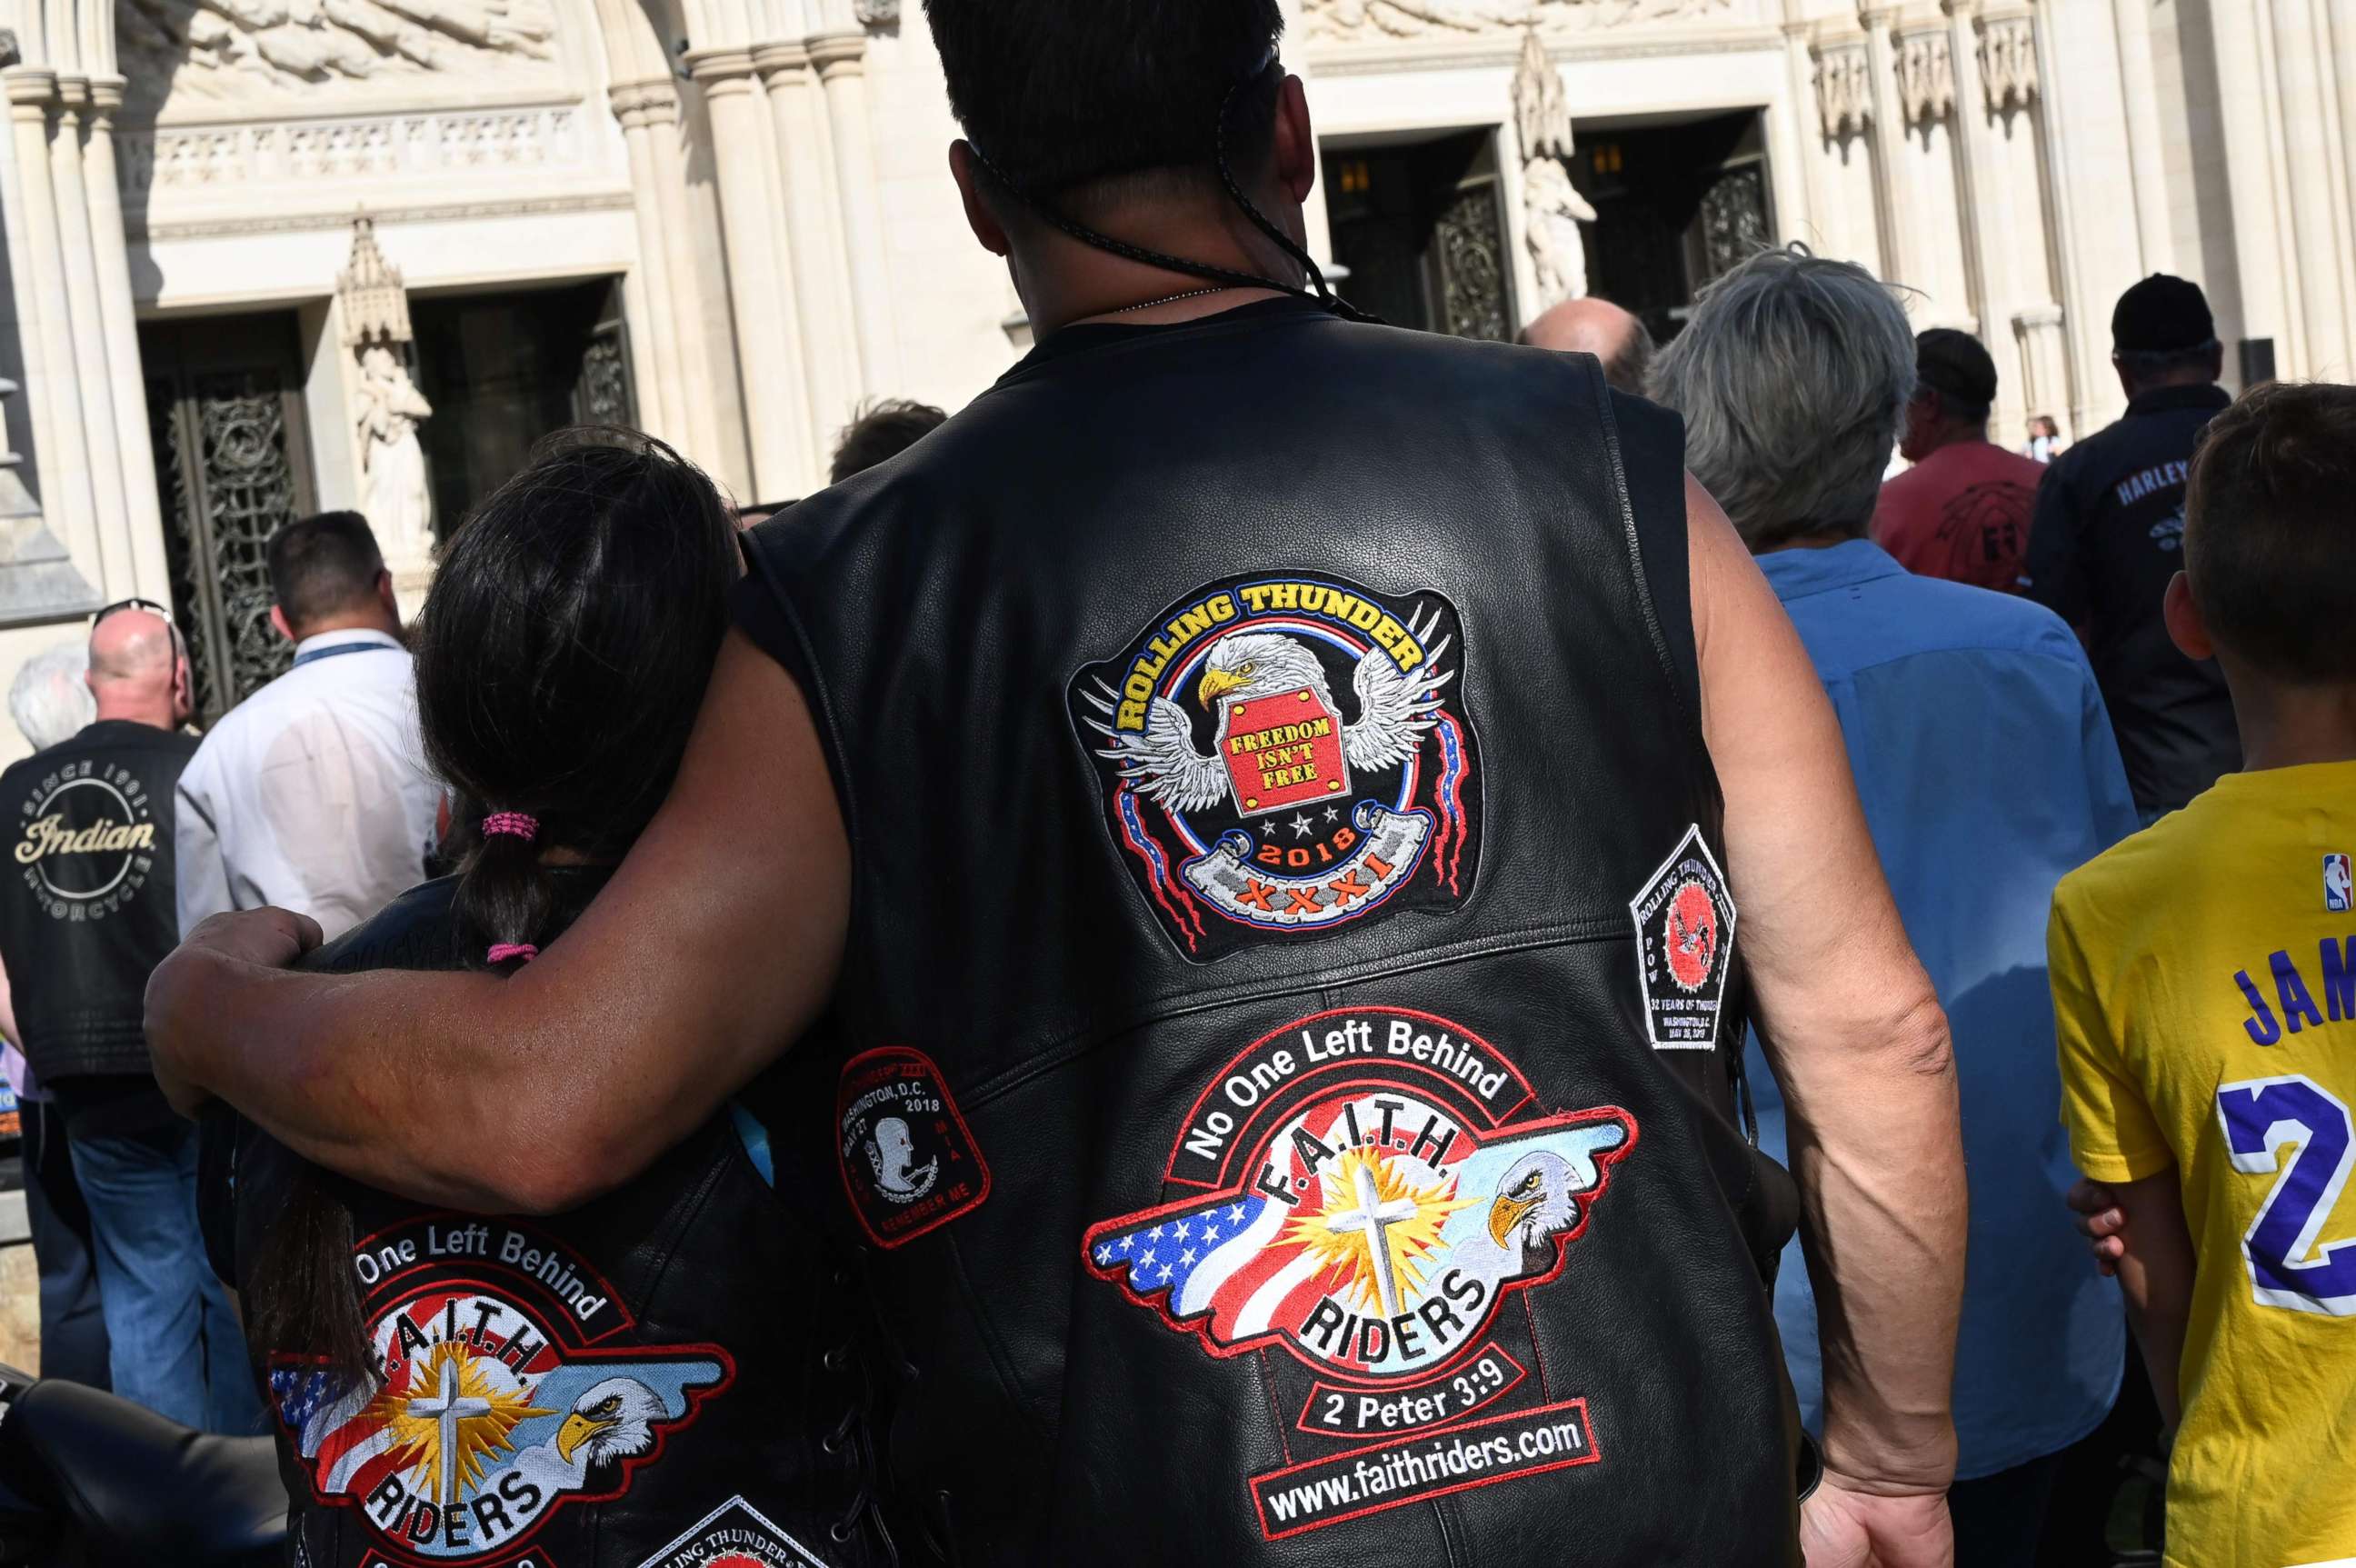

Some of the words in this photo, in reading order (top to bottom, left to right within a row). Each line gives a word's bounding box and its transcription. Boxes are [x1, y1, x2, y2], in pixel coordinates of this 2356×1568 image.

[2117, 460, 2188, 506] HARLEY
[1117, 594, 1234, 731] ROLLING
[1241, 584, 1422, 673] THUNDER
[1229, 717, 1331, 756] FREEDOM
[1263, 762, 1318, 790] FREE
[15, 813, 155, 864] Indian
[1257, 826, 1355, 867] 2018
[1237, 856, 1393, 914] XXXI
[1639, 872, 1678, 926] ROLLING
[1678, 858, 1717, 894] THUNDER
[1651, 998, 1660, 1011] 32
[1661, 999, 1684, 1011] YEARS
[1686, 999, 1695, 1011] OF
[855, 1118, 868, 1135] 27
[905, 1098, 940, 1113] 2018
[900, 1081, 925, 1098] D.C.
[1184, 1110, 1233, 1162] No
[1225, 1046, 1296, 1106] One
[1302, 1019, 1374, 1064] Left
[1387, 1019, 1507, 1101] Behind
[355, 1238, 417, 1284] One
[428, 1224, 488, 1256] Left
[499, 1229, 607, 1322] Behind
[1301, 1268, 1485, 1363] RIDERS
[1323, 1394, 1343, 1426] 2
[1357, 1389, 1447, 1430] Peter
[1454, 1358, 1504, 1405] 3:9
[1268, 1419, 1582, 1523] www.faithriders.com
[366, 1469, 544, 1549] RIDERS
[705, 1529, 788, 1565] THUNDER
